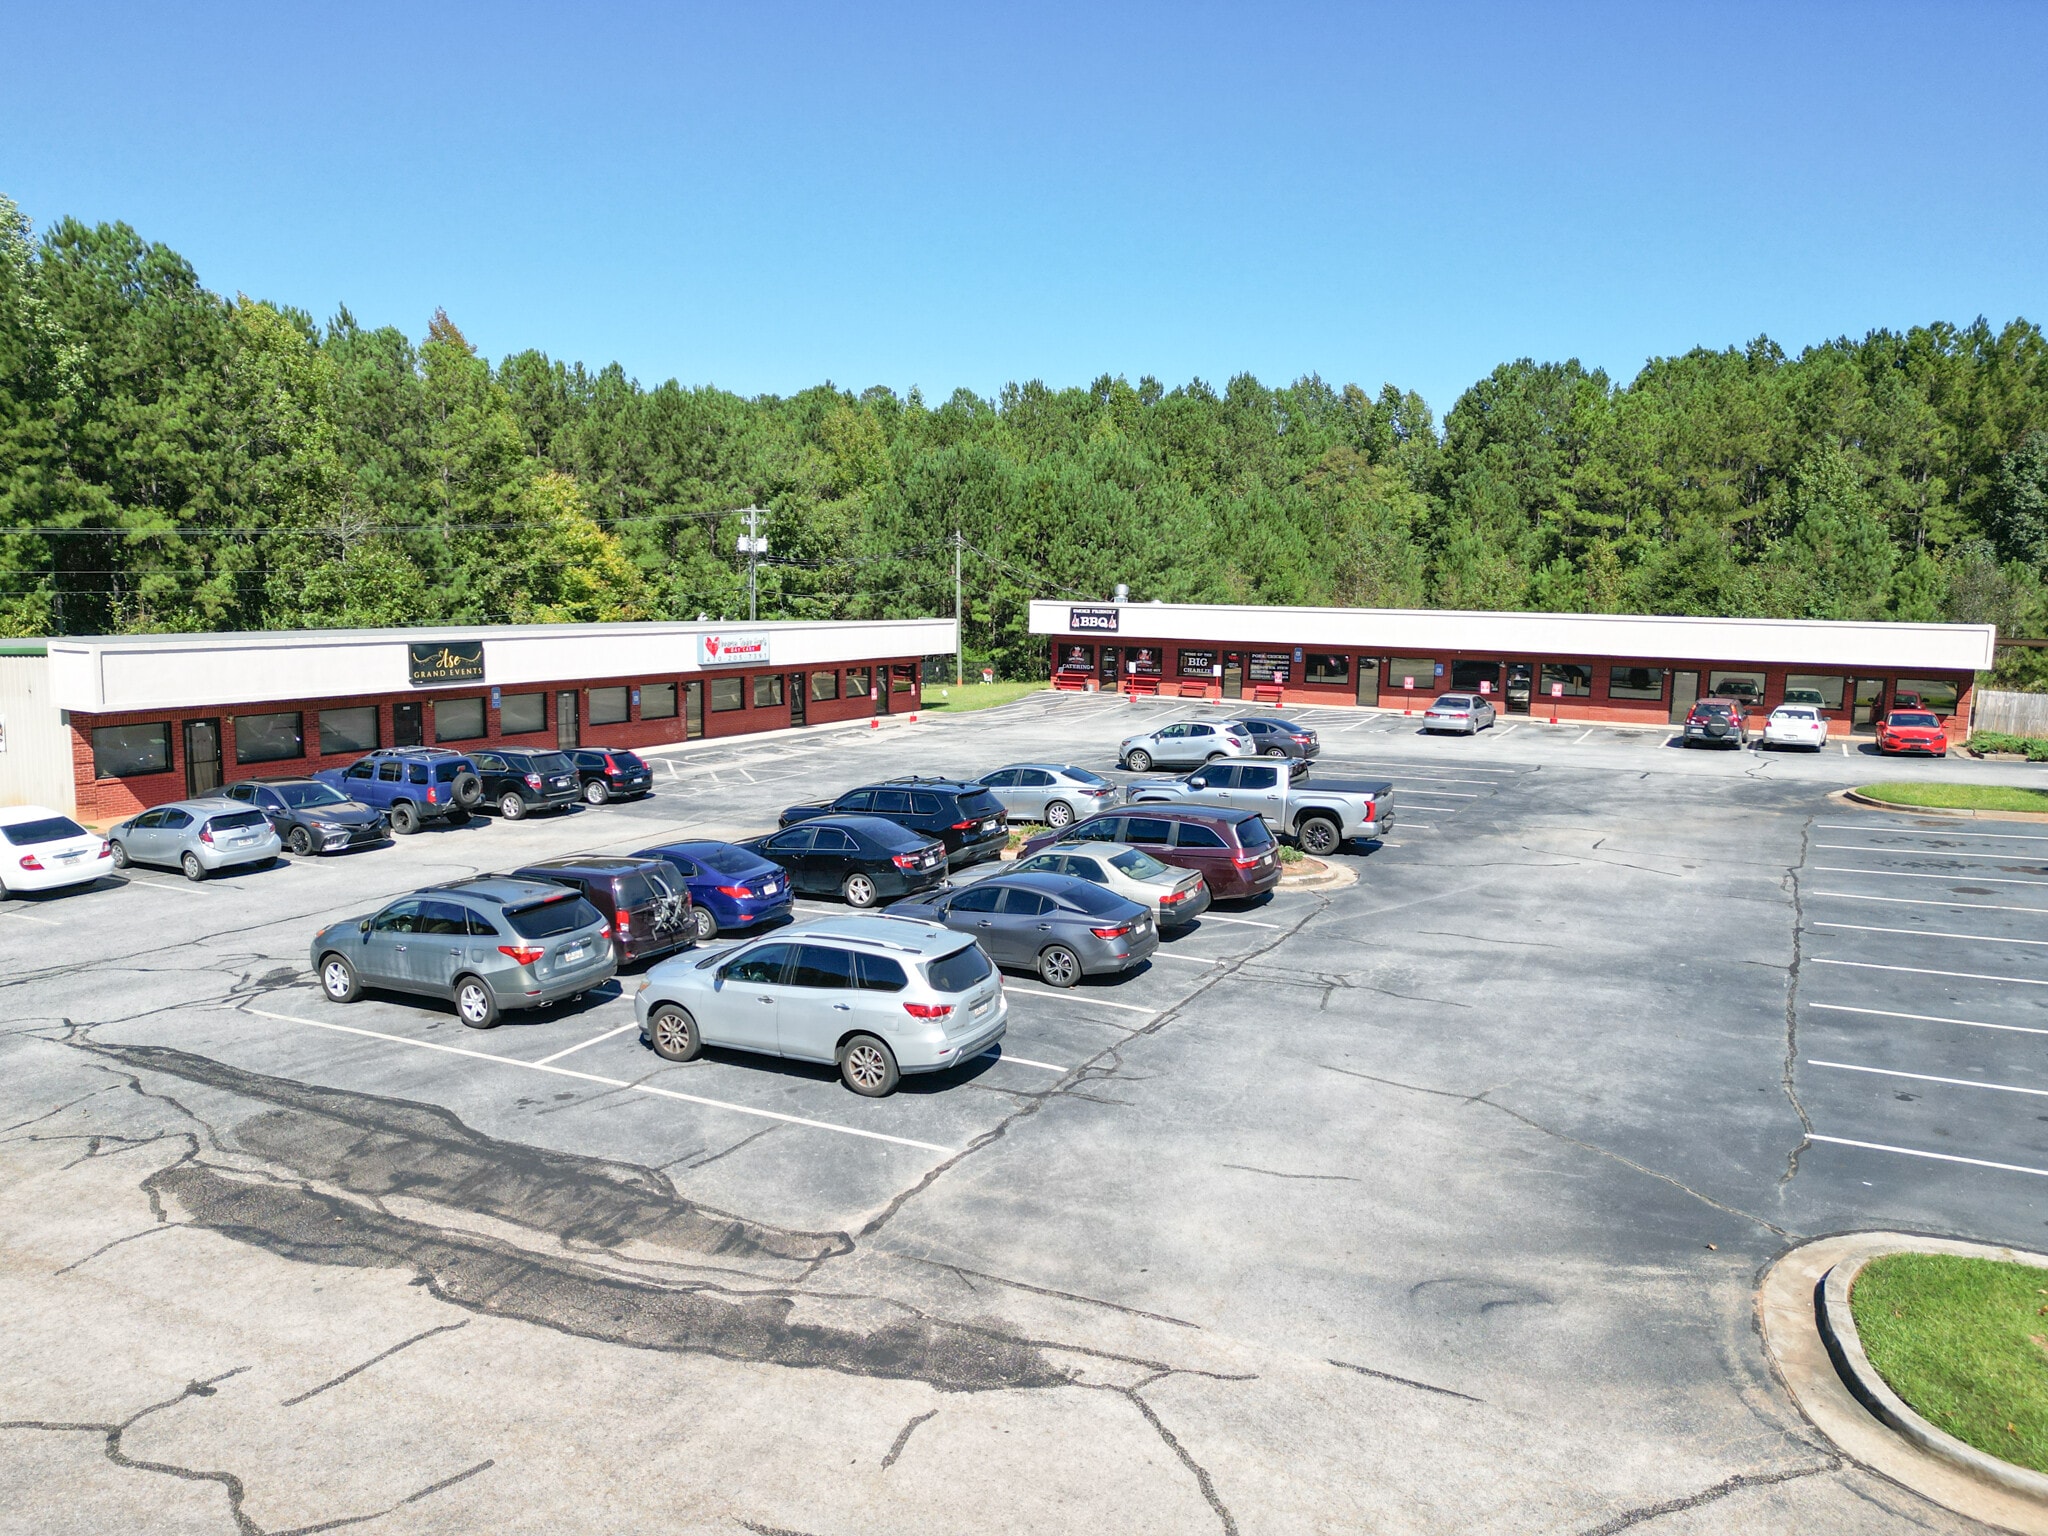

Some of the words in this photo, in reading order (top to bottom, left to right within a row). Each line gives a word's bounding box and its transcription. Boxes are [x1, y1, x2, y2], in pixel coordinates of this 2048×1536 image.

[1080, 616, 1108, 628] BBQ
[1188, 658, 1208, 666] BIG
[414, 670, 446, 678] GRAND
[450, 668, 482, 676] EVENTS
